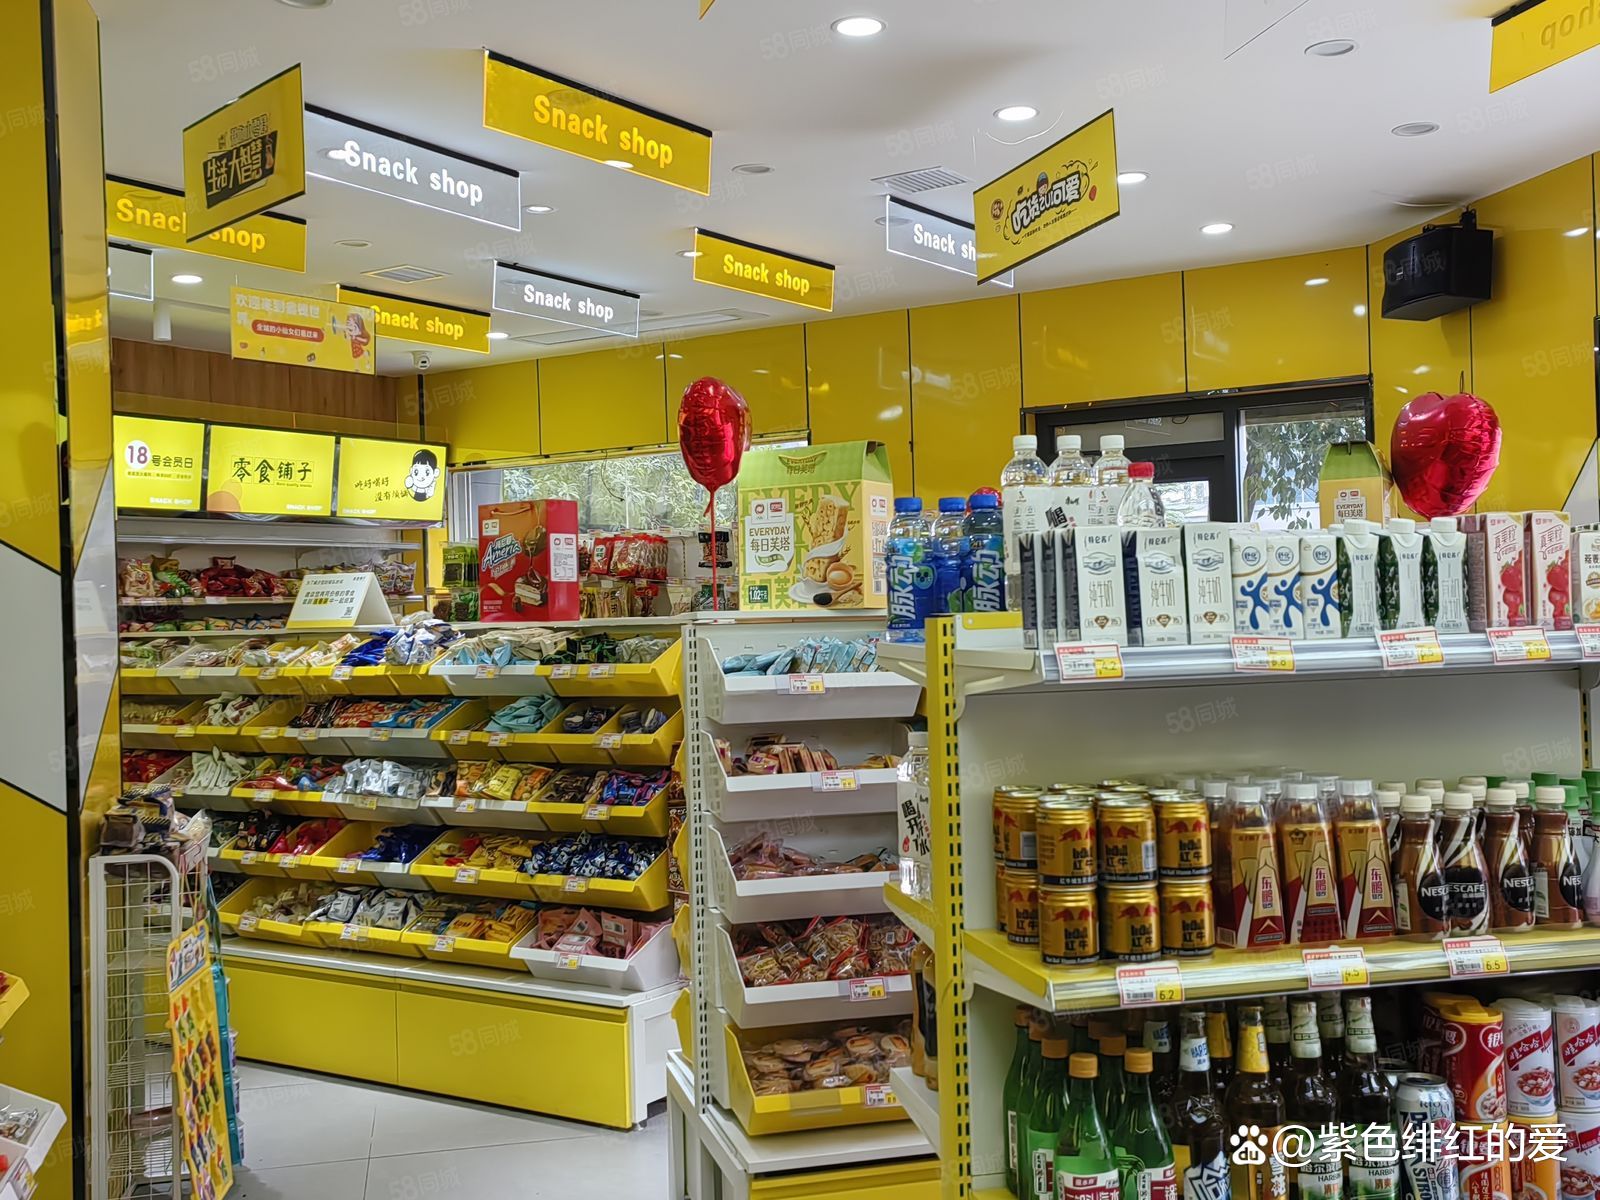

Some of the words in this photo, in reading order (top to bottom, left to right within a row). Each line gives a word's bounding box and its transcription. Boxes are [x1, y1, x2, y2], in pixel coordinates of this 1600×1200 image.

[533, 94, 608, 146] Snack
[620, 126, 673, 168] shop
[207, 139, 263, 196] 生活大智慧
[343, 140, 418, 186] Snack
[430, 168, 483, 206] shop
[913, 223, 956, 255] Snack
[961, 240, 976, 262] sh
[723, 254, 770, 284] Snack
[775, 268, 810, 296] shop
[523, 284, 572, 312] Snack
[578, 298, 614, 322] shop
[370, 304, 419, 330] Snack
[426, 316, 464, 340] shop
[128, 445, 148, 464] 18
[152, 454, 193, 468] 号会员日
[232, 458, 312, 484] 零食铺子
[750, 526, 790, 537] EVERYDAY
[750, 536, 790, 553] 每日芙塔
[890, 555, 919, 620] 脉动
[971, 550, 1004, 612] 脉动
[1072, 860, 1093, 870] 红牛
[1107, 858, 1128, 866] 红牛
[1181, 852, 1202, 862] 红牛
[1262, 876, 1274, 904] 东鹏
[1315, 868, 1326, 892] 东鹏
[1371, 868, 1383, 894] 东鹏
[1016, 920, 1038, 930] 红牛
[1065, 940, 1088, 950] 红牛
[1132, 937, 1153, 948] 红牛
[1183, 932, 1204, 942] 红牛
[1486, 960, 1500, 970] 6.5
[1508, 1038, 1540, 1061] 娃哈哈
[1564, 1034, 1595, 1057] 娃哈哈
[1368, 1168, 1395, 1176] HARBIN
